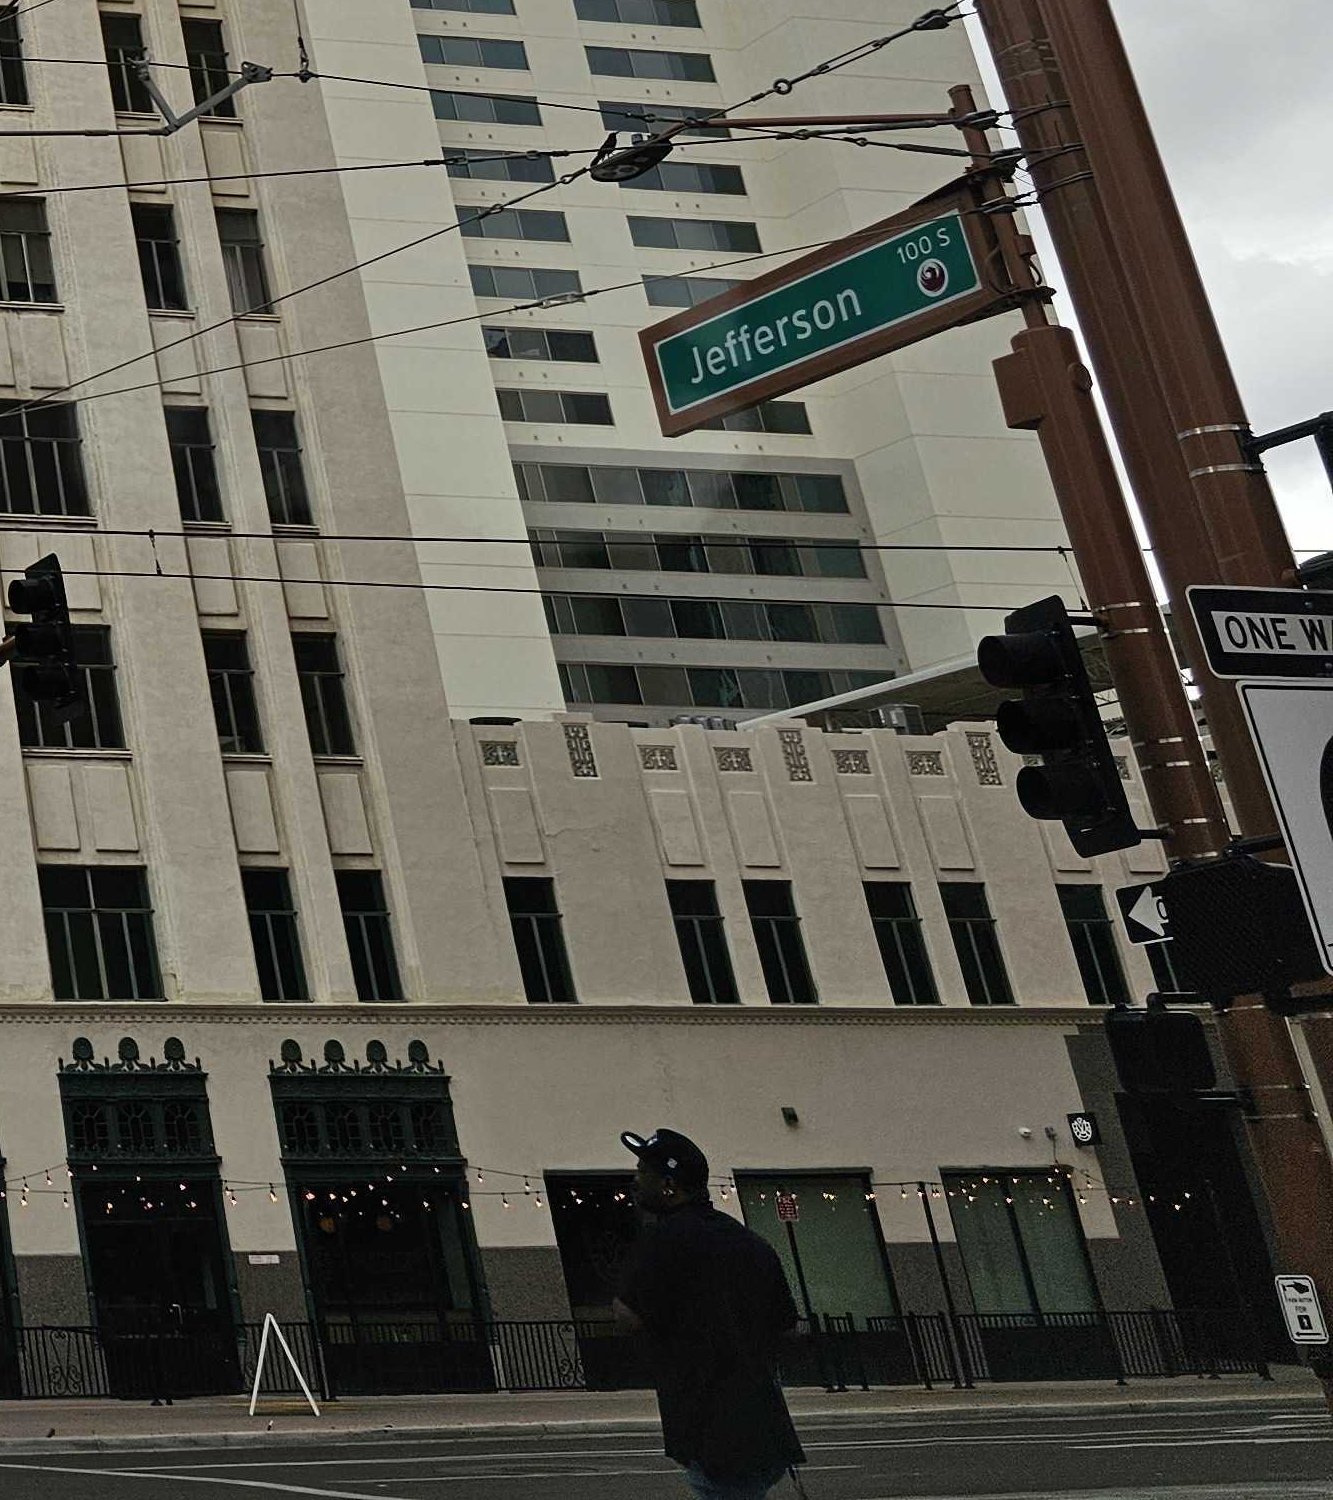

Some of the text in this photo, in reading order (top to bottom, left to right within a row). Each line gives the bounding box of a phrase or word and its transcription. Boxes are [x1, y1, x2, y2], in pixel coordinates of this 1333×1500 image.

[896, 227, 950, 264] 100 S
[691, 286, 861, 384] Jefferson
[1225, 615, 1333, 652] ONE W
